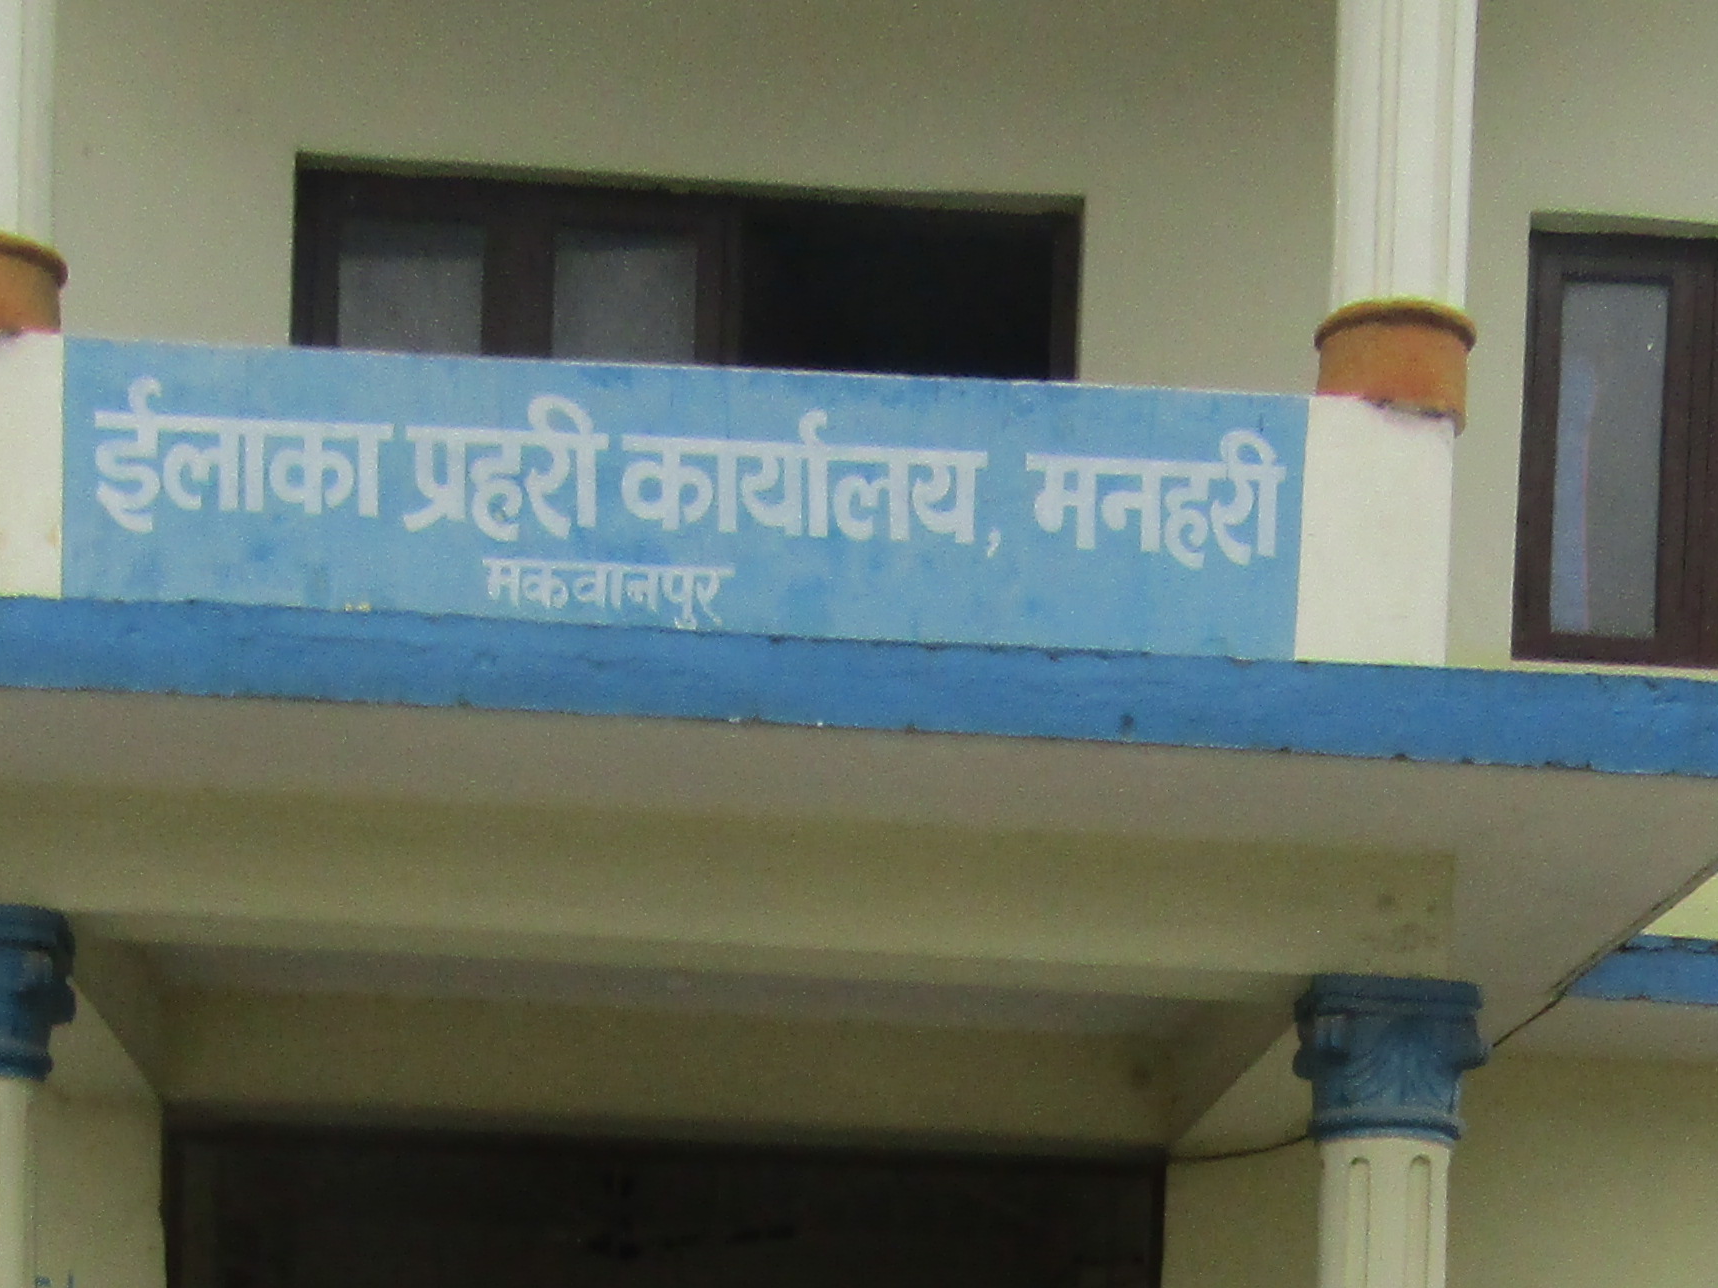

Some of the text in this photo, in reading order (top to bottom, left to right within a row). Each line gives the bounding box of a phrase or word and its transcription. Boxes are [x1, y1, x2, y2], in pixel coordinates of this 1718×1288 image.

[95, 376, 1286, 569] ईलाका प्रहरी कार्यालय, मनहरी
[483, 558, 734, 630] मकवानपुर
